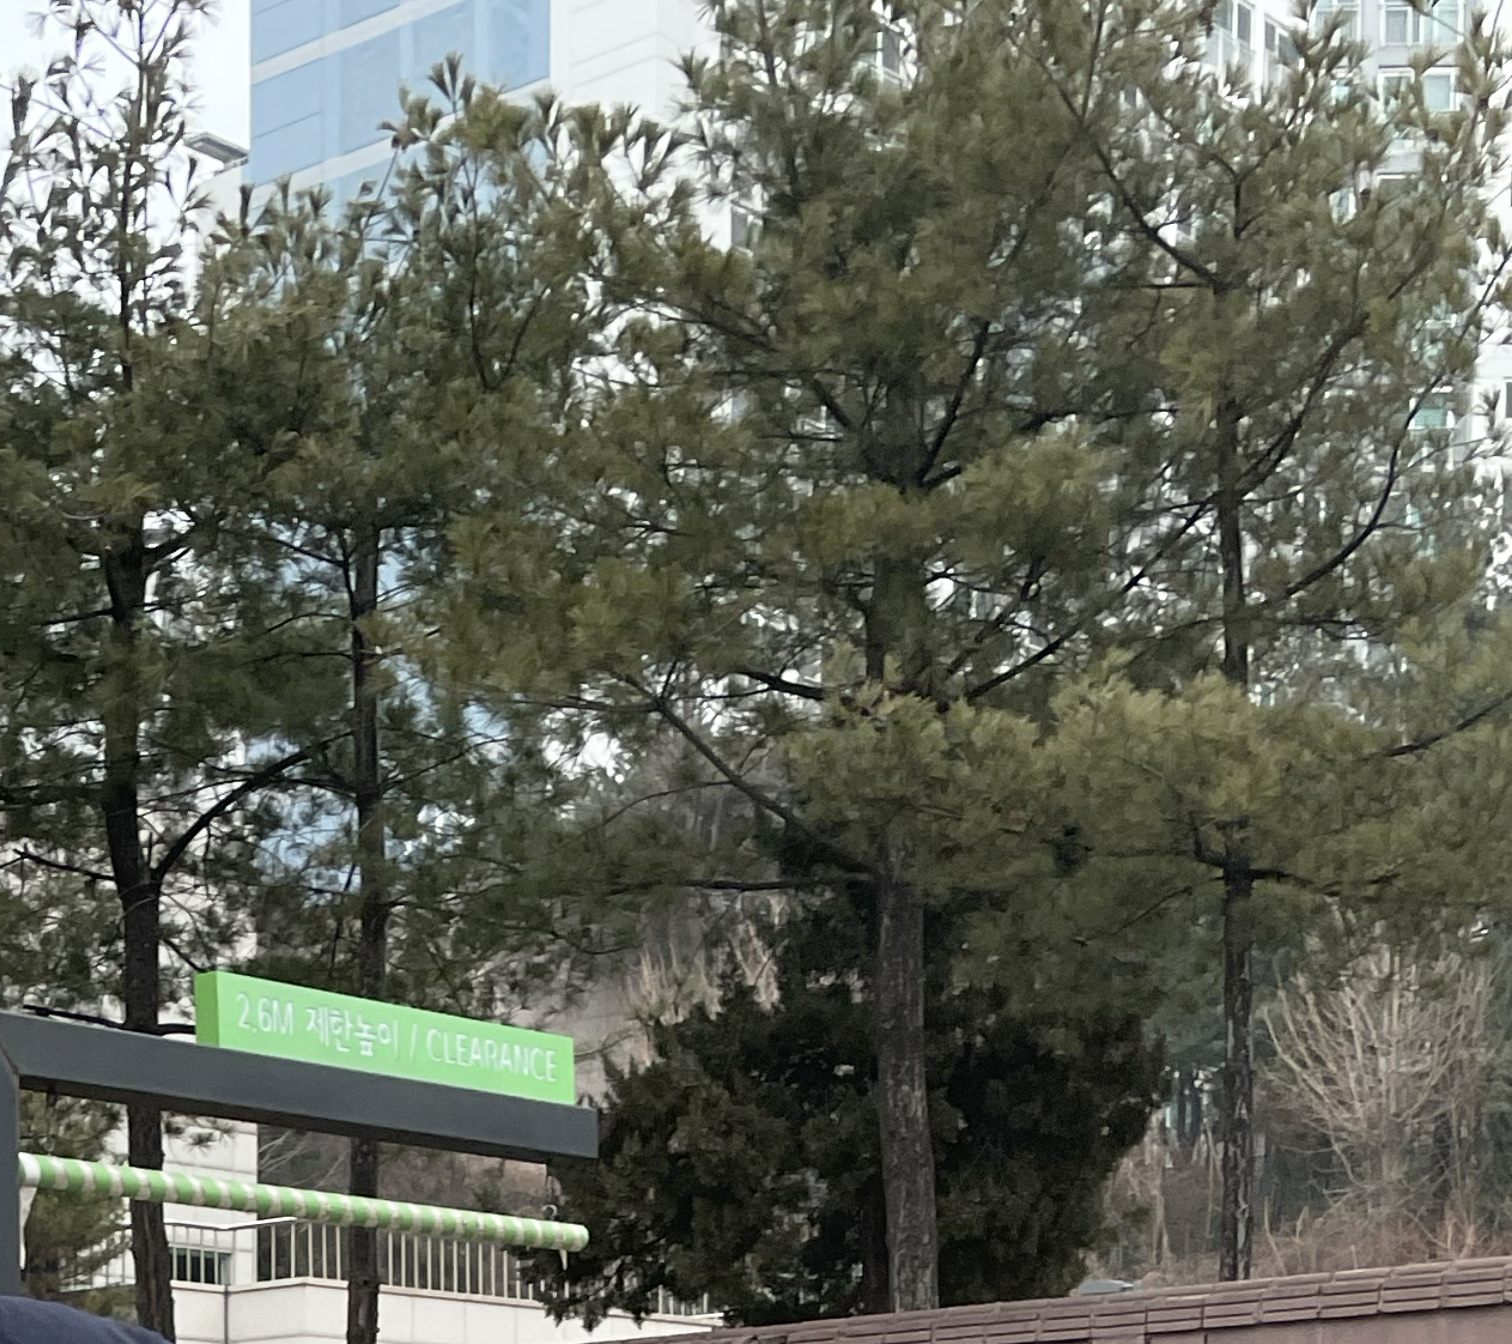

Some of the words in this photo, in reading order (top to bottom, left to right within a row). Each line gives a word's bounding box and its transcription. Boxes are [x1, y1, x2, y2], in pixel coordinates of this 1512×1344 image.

[237, 993, 294, 1035] 2.6M
[306, 1007, 399, 1057] 제한높이
[426, 1028, 557, 1082] CLEARANCE
